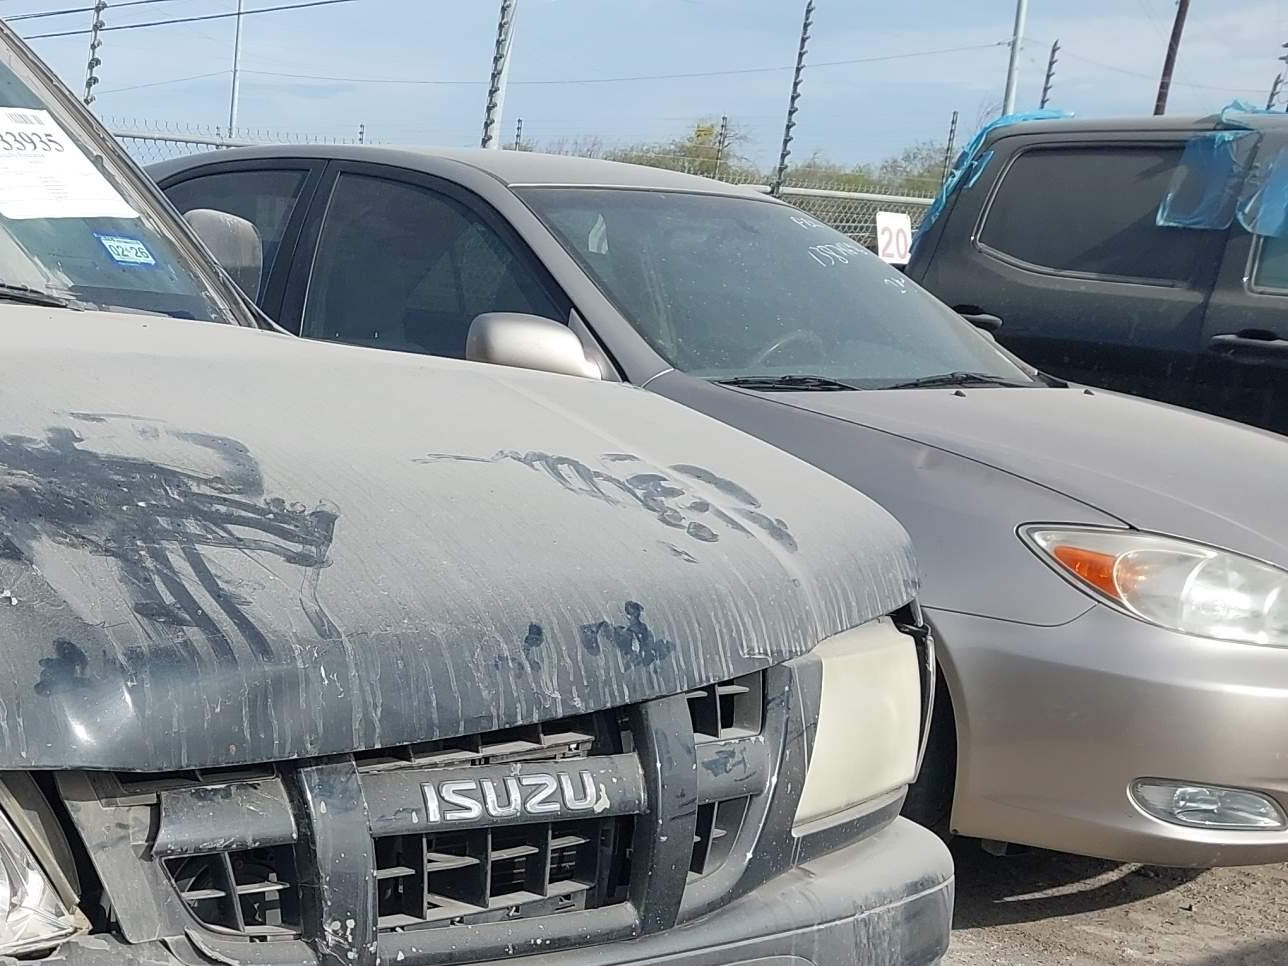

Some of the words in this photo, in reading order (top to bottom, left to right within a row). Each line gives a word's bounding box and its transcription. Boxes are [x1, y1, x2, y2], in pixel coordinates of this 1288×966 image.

[108, 244, 129, 257] 02
[131, 246, 150, 259] 26
[880, 226, 909, 260] 20
[420, 770, 597, 824] ISUZU
